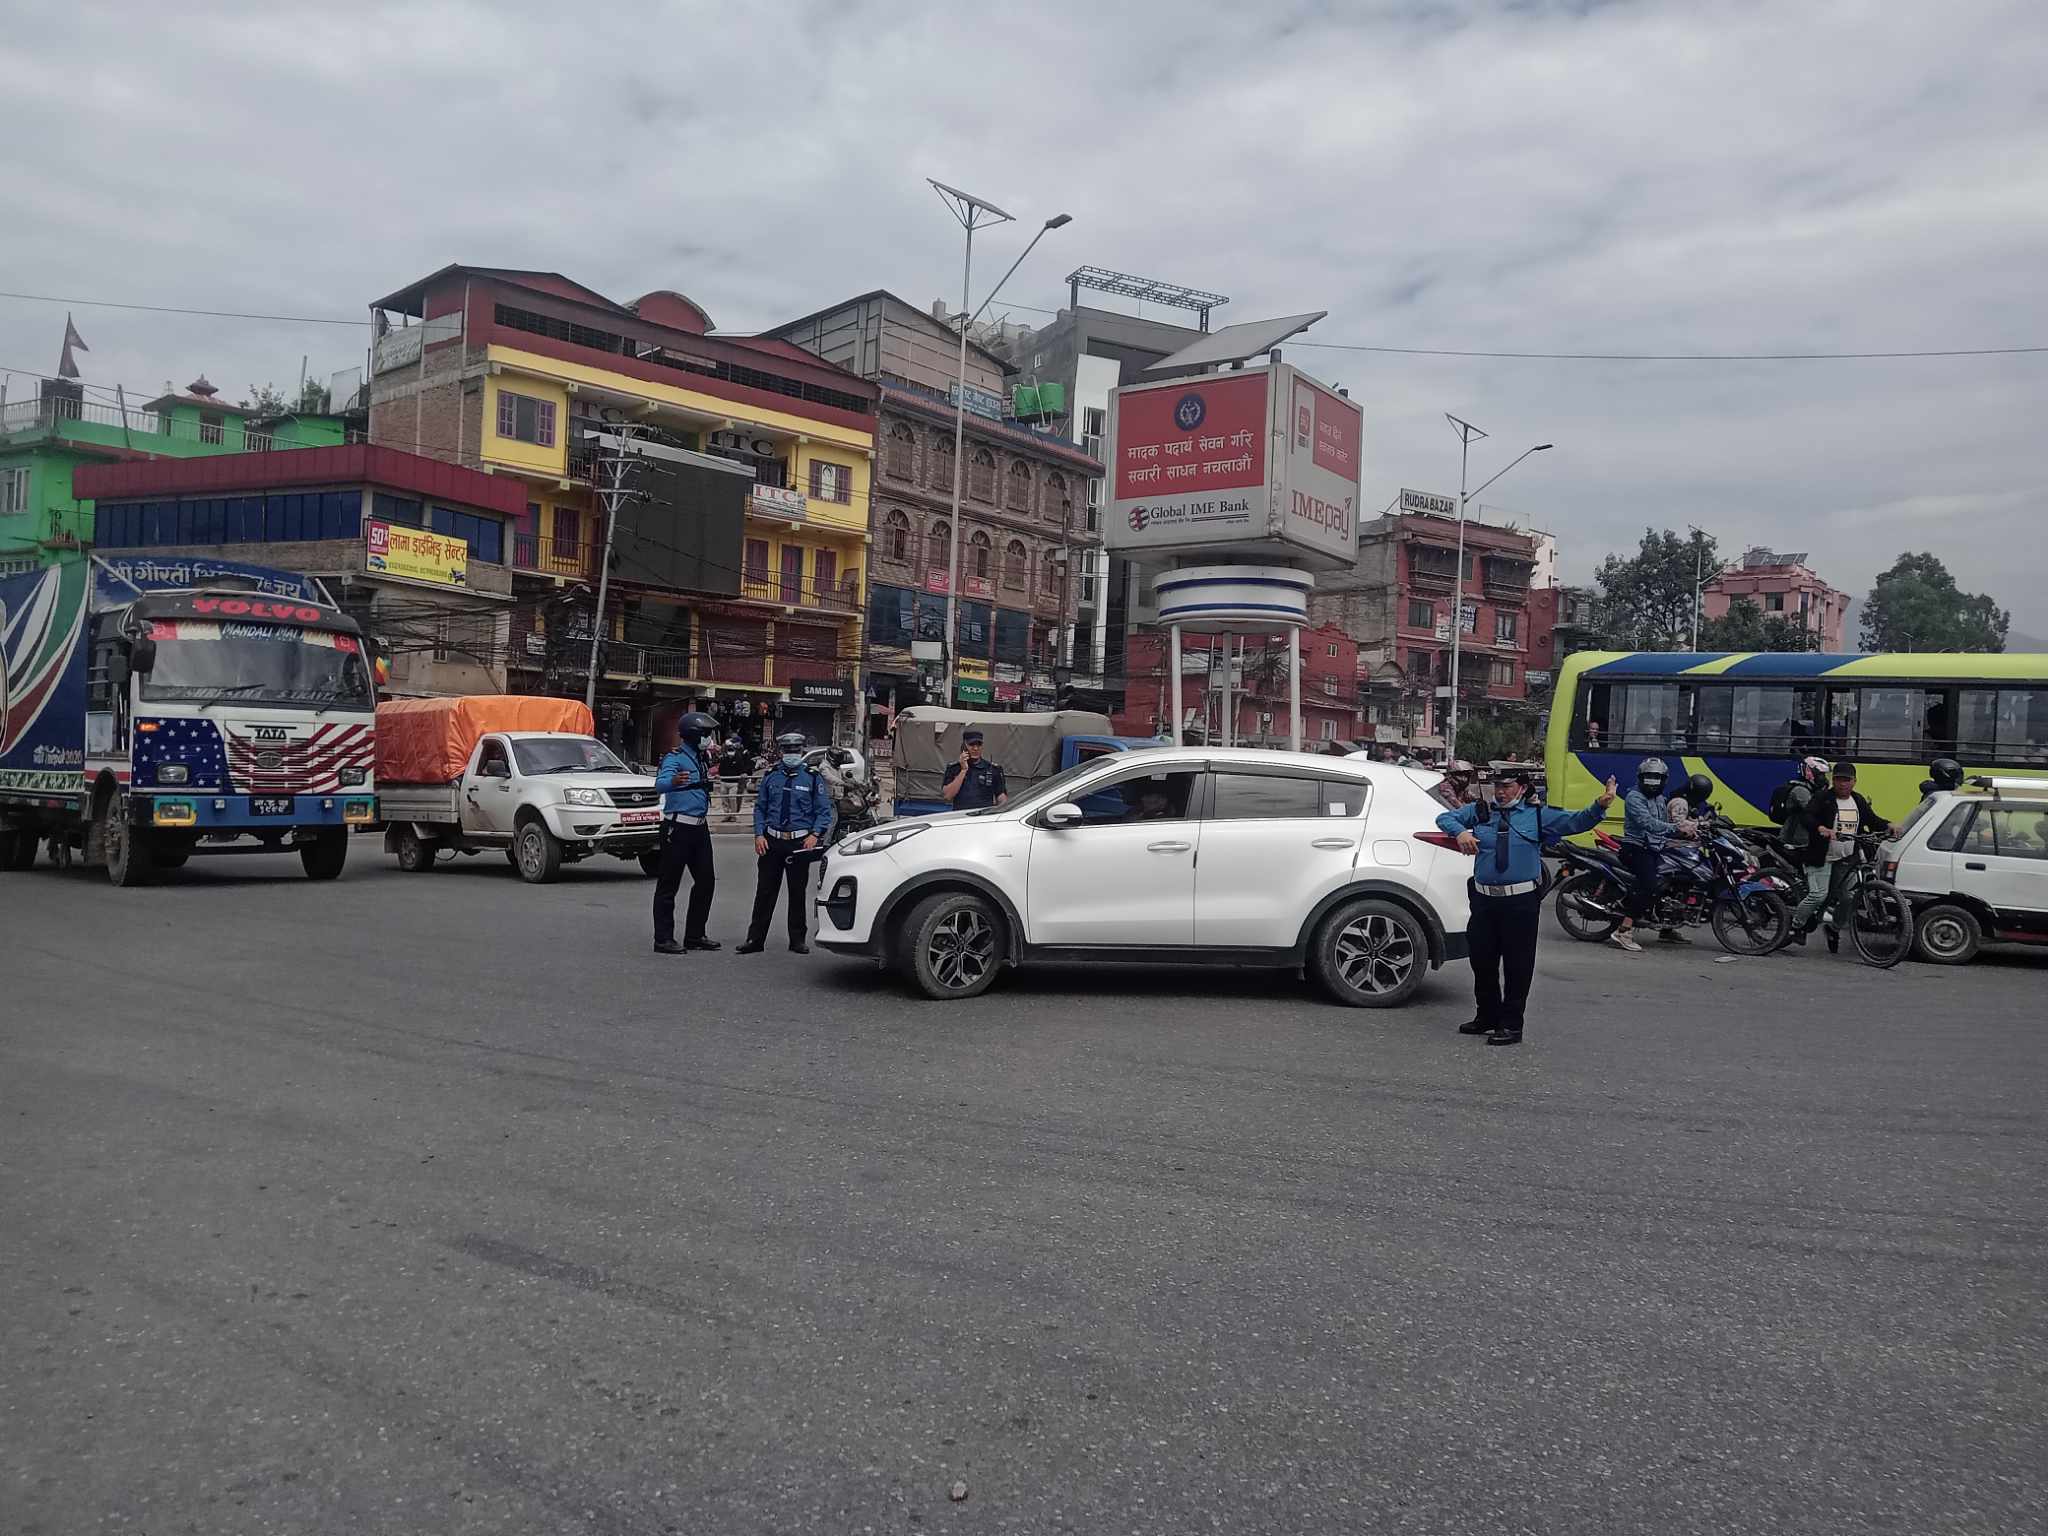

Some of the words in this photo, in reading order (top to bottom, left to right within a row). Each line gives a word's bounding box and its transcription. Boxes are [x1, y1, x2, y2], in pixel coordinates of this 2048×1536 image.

[1128, 445, 1160, 459] मादक
[1199, 435, 1226, 453] सेवन
[1128, 464, 1161, 484] सवारी
[1166, 463, 1198, 480] साधन
[1150, 504, 1186, 519] Global
[1191, 502, 1216, 515] IME
[1220, 499, 1249, 513] Bank
[1404, 492, 1429, 509] RUDRA
[1429, 498, 1455, 514] BAZAR
[192, 599, 321, 622] VOLVO
[804, 686, 843, 697] SAMSUNG
[255, 729, 287, 740] TATA
